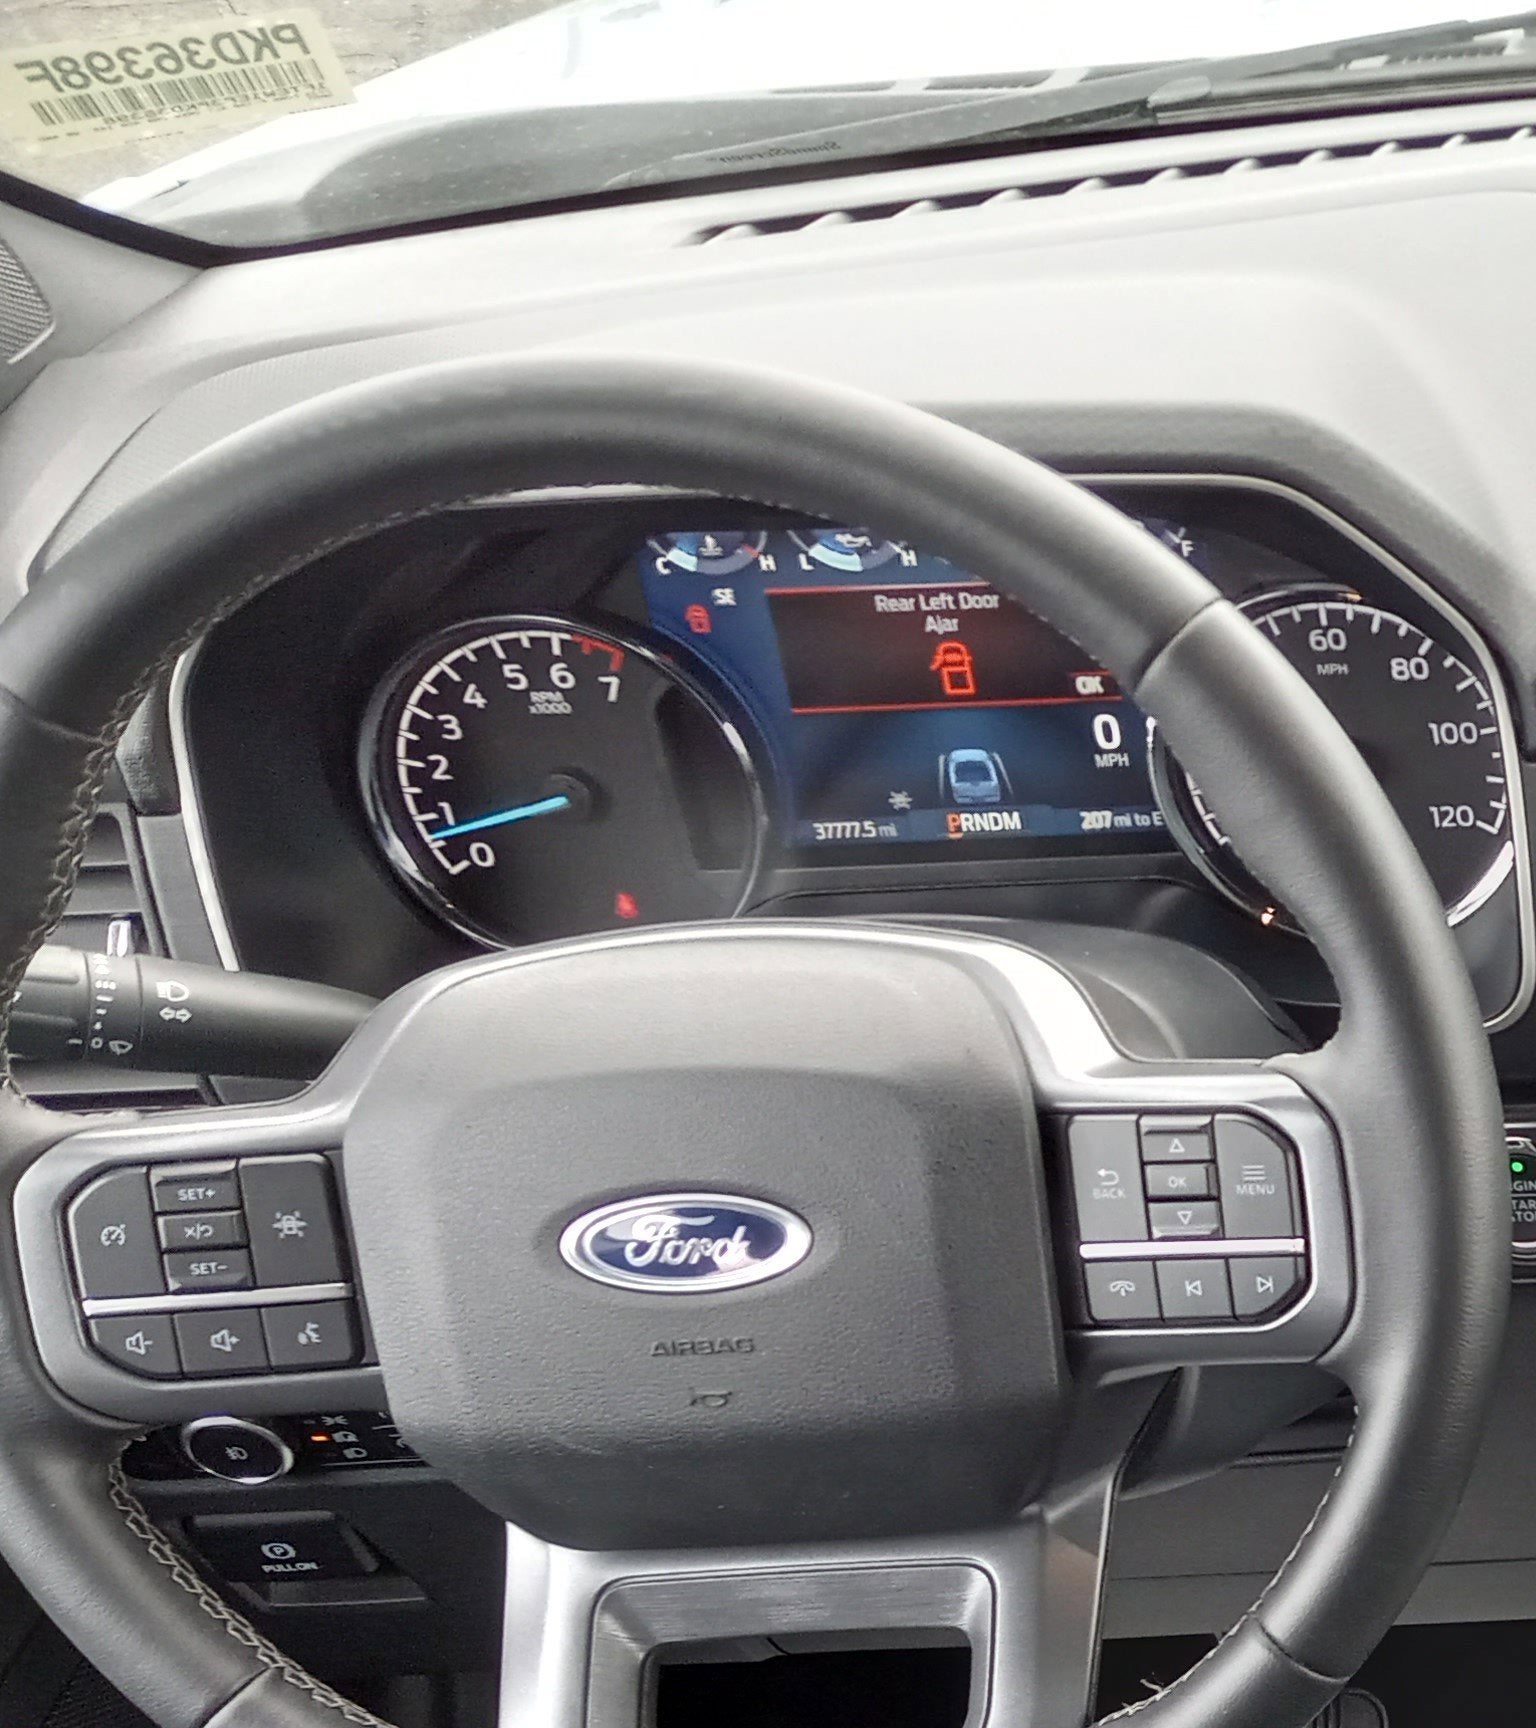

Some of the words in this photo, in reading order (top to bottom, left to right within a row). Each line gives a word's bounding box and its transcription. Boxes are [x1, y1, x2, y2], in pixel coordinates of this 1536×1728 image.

[758, 554, 778, 573] H
[798, 553, 815, 572] L
[710, 587, 738, 607] SE
[873, 594, 916, 613] Rear
[918, 592, 957, 612] Left
[958, 591, 1000, 611] Door
[924, 614, 960, 636] Ajar
[1308, 628, 1348, 652] 60
[501, 663, 529, 691] 5
[550, 662, 577, 690] 6
[1316, 662, 1349, 676] MPH
[1389, 656, 1430, 681] 80
[462, 683, 489, 709] 4
[529, 690, 565, 703] RPM
[597, 675, 621, 703] 7
[1075, 675, 1105, 696] OK
[437, 714, 464, 741] 3
[1092, 713, 1122, 751] 0
[1427, 721, 1479, 746] 100
[426, 754, 455, 781] 2
[1093, 753, 1130, 768] MPH
[436, 801, 456, 826] 1
[946, 811, 1023, 833] PRNDM
[1078, 810, 1112, 830] 207
[1113, 810, 1132, 828] mi
[1133, 811, 1151, 828] to
[1428, 804, 1476, 829] 120
[812, 820, 877, 841] 37777.5
[878, 822, 899, 838] mi
[468, 841, 496, 868] 0
[1092, 1187, 1126, 1200] BACK
[1167, 1176, 1188, 1189] OK
[1235, 1183, 1276, 1196] MENU
[176, 1187, 216, 1202] SET+
[622, 1212, 752, 1270] Ford
[650, 1336, 757, 1358] AIRBAG
